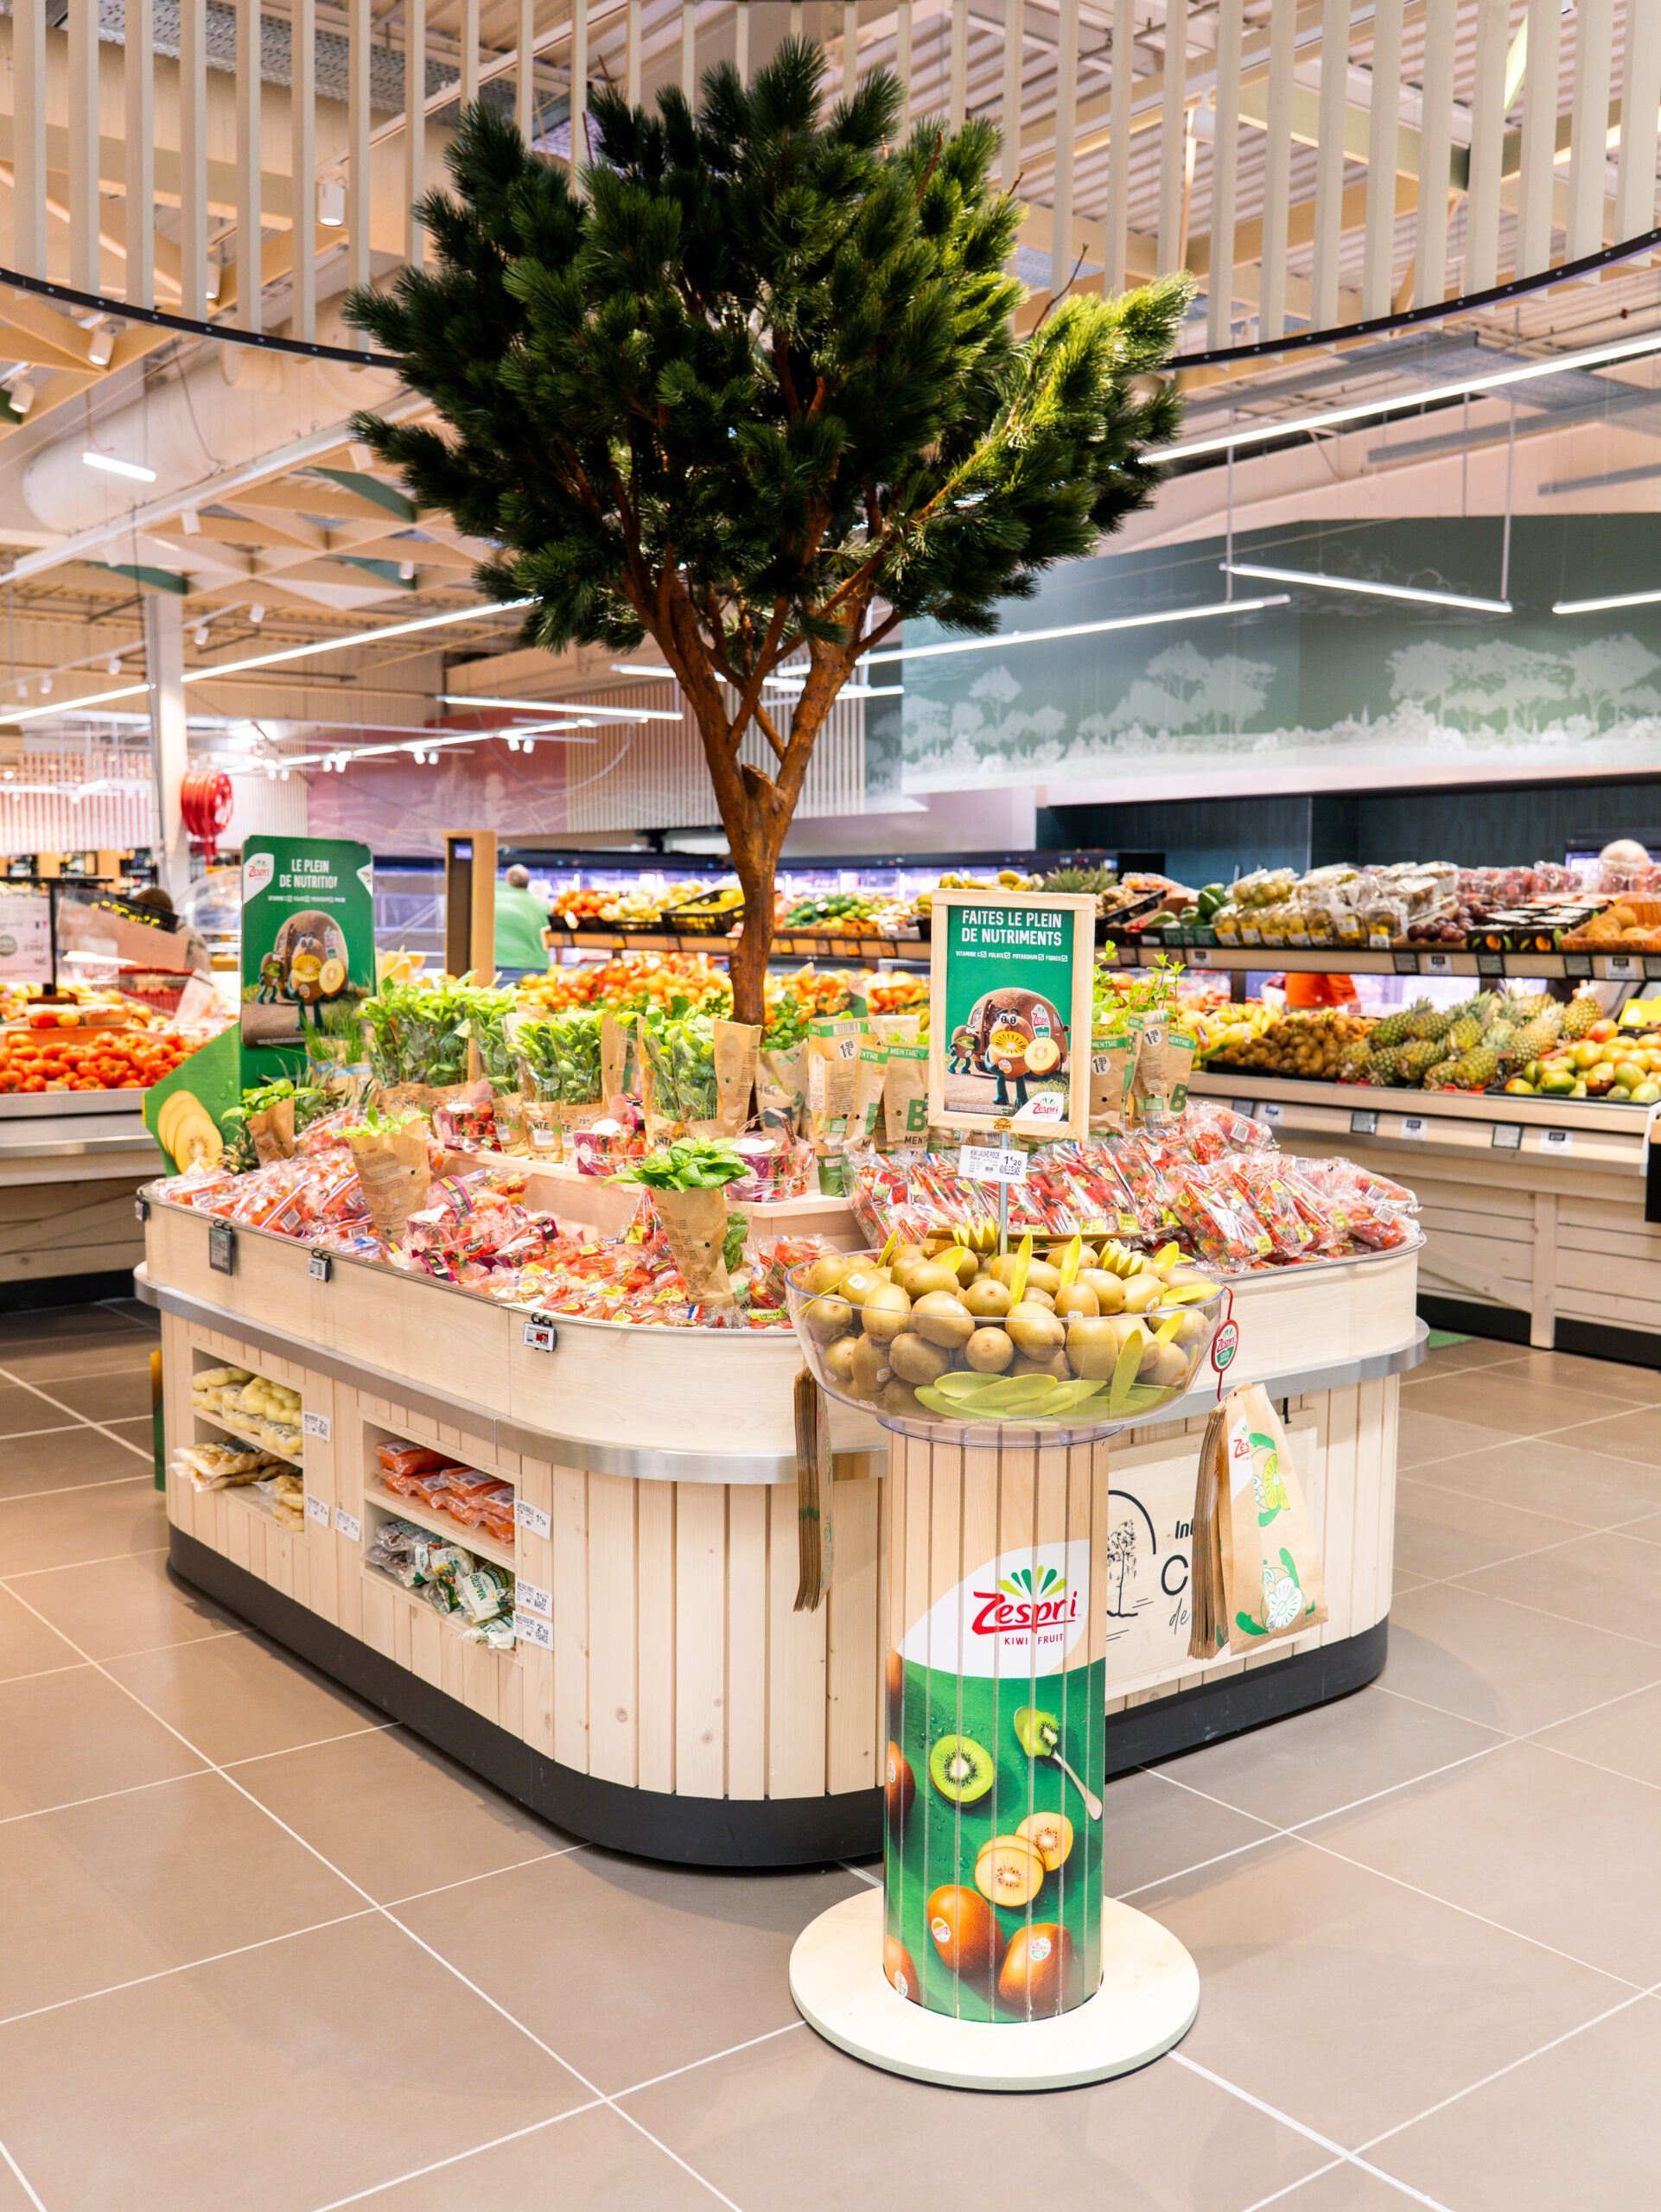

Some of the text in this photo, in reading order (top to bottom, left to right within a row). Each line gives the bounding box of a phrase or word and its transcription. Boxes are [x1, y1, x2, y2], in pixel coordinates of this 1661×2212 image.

[291, 859, 330, 873] LE PLEIN
[279, 874, 293, 888] DE
[962, 910, 1062, 928] FAITES LE PLEIN
[961, 927, 1062, 946] DE NUTRIMENTS
[860, 1050, 879, 1060] ENTHE
[890, 1047, 919, 1057] MENTHE
[1033, 1103, 1059, 1115] Zespri
[1216, 1335, 1236, 1354] Zespri
[971, 1591, 1078, 1636] Zespri
[1004, 1633, 1064, 1645] KIWI FRUIT
